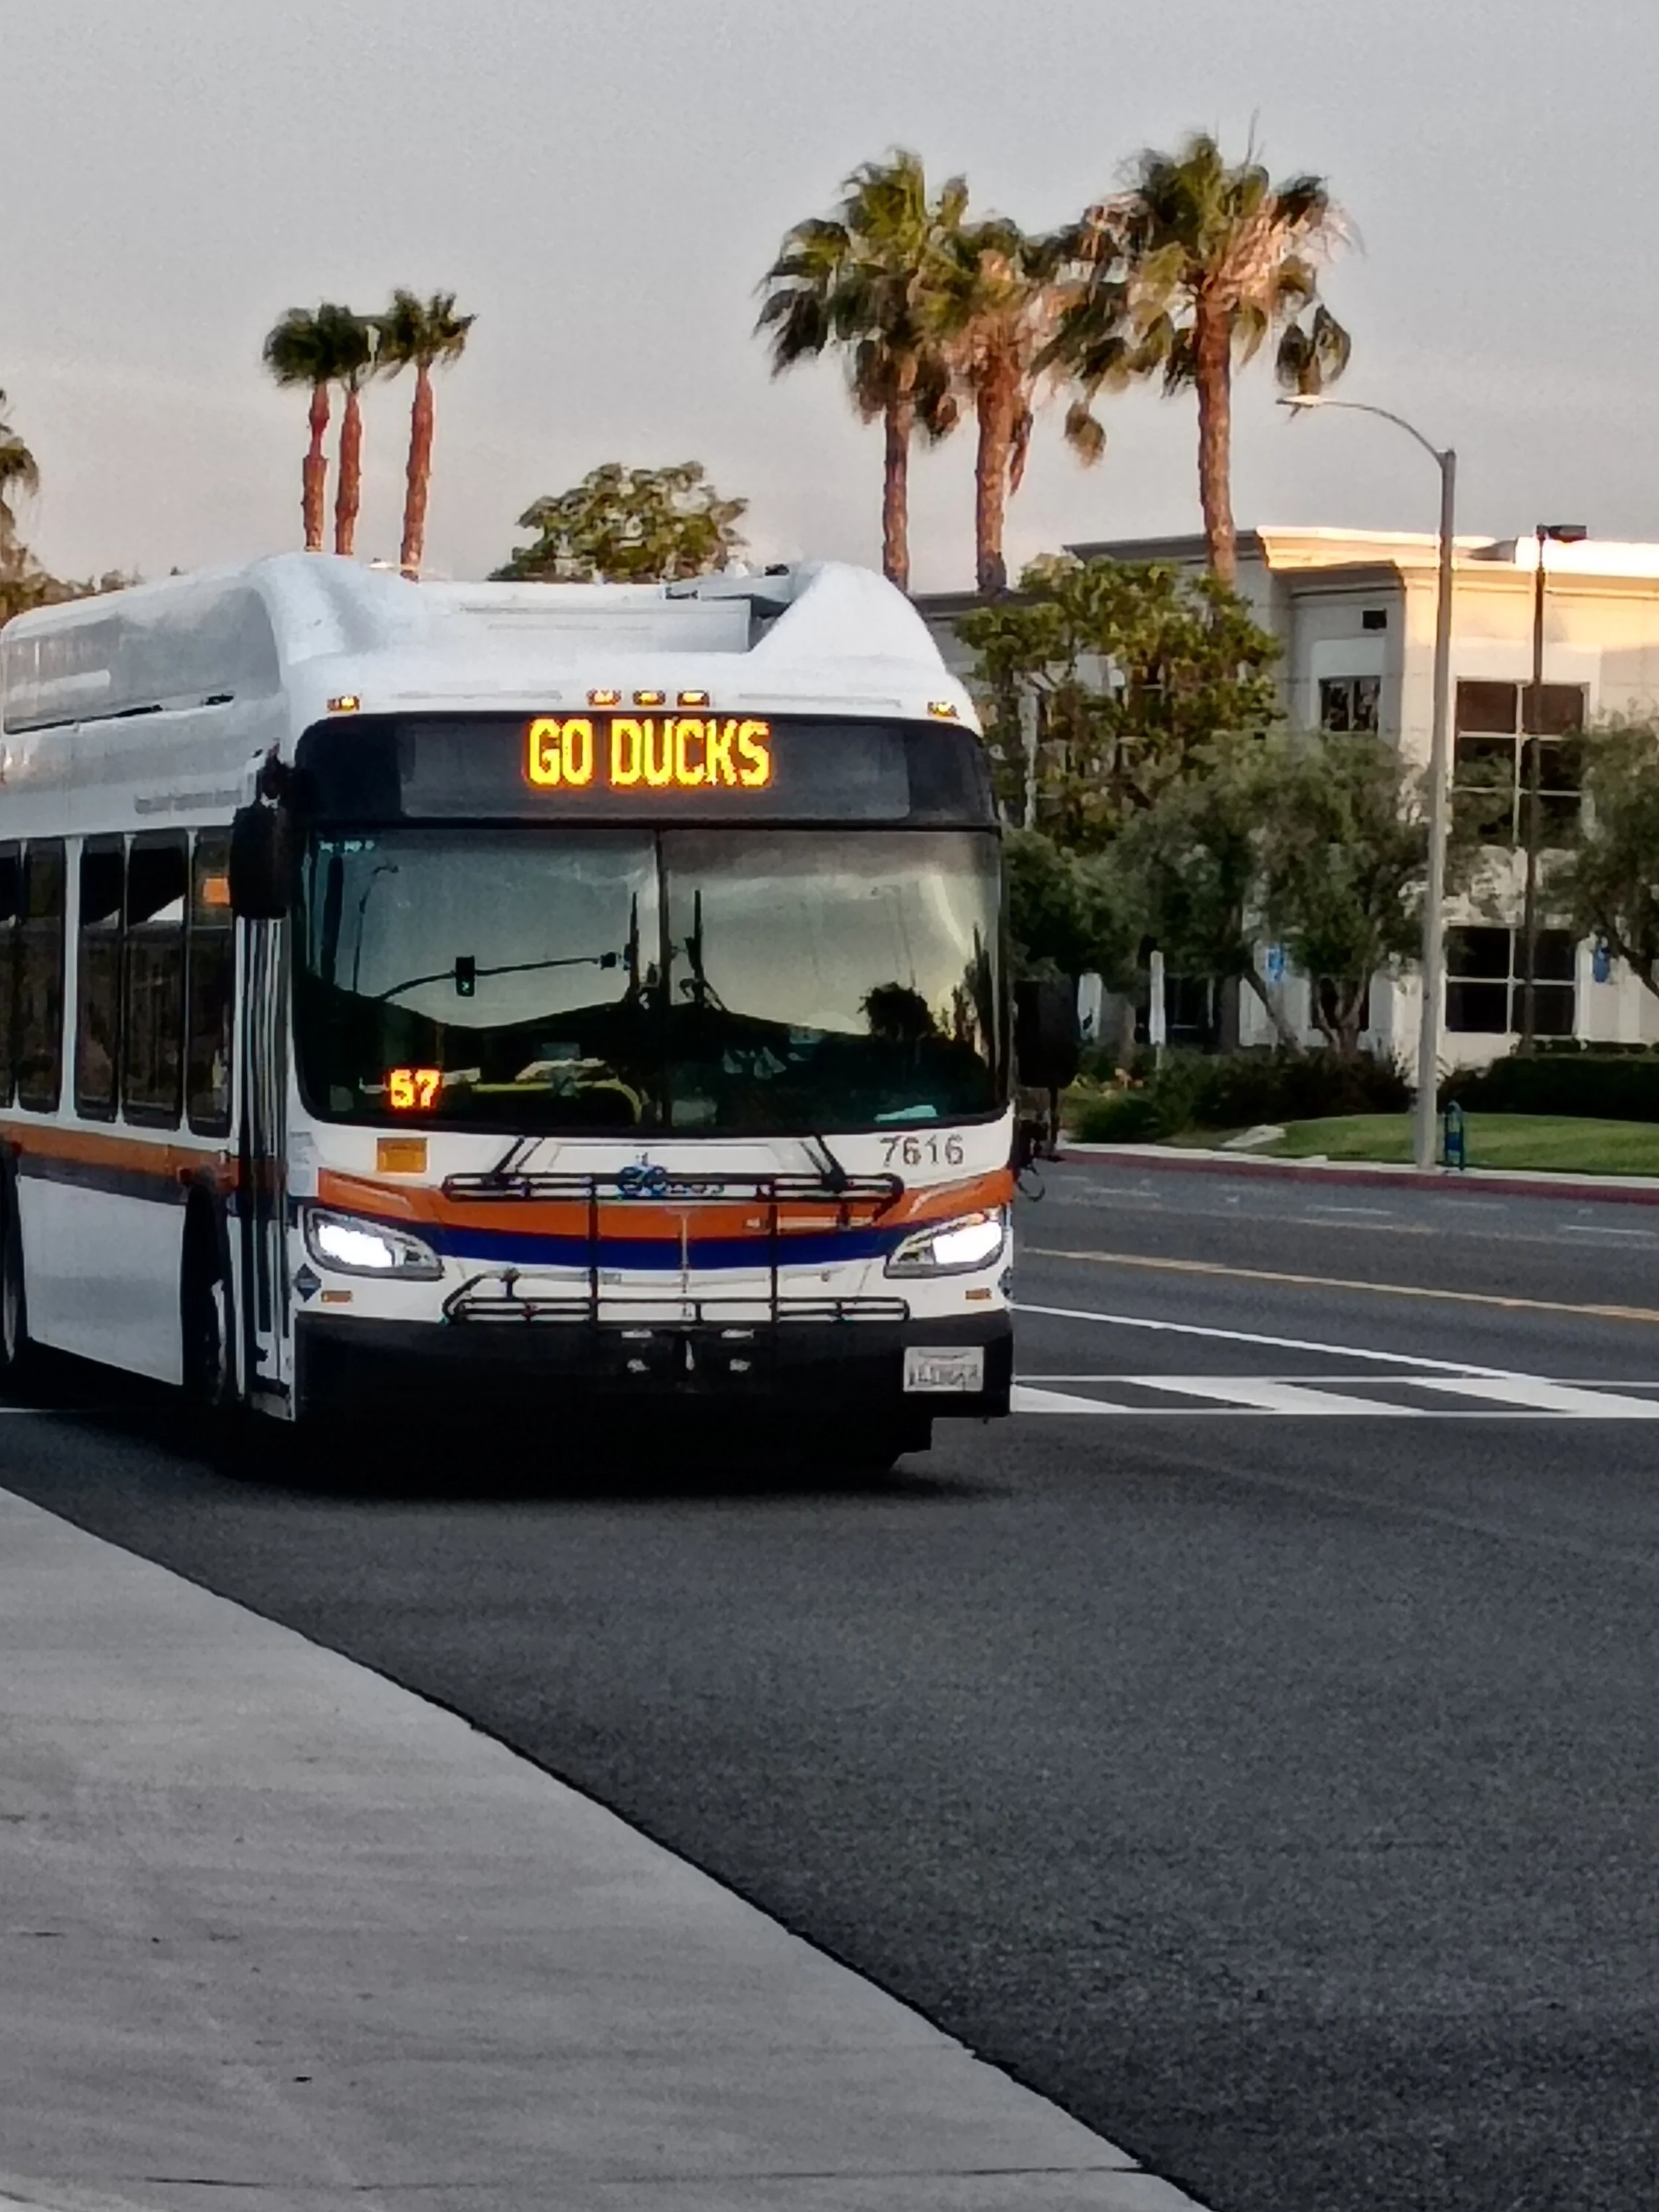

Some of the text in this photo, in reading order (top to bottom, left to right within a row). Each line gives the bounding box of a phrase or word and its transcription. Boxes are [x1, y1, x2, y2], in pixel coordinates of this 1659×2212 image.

[528, 717, 770, 786] GO DUCKS
[879, 1134, 964, 1167] 7616
